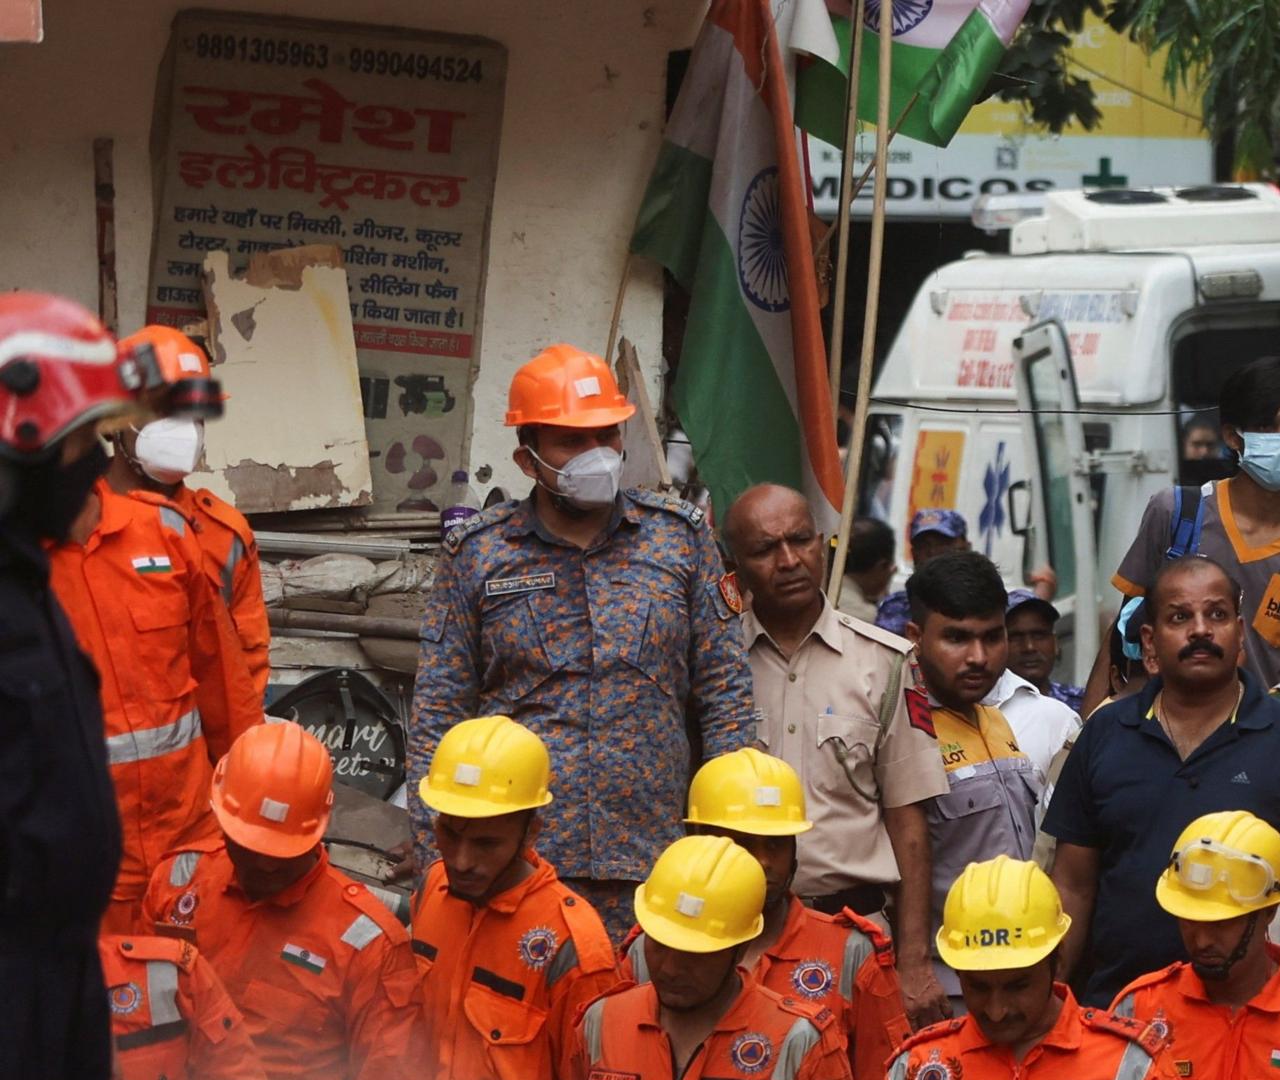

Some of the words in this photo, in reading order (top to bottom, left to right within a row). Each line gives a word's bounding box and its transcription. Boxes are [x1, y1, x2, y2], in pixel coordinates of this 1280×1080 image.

[196, 33, 329, 69] 9891305963
[350, 48, 484, 83] 9990494524
[183, 77, 467, 155] रमेश
[178, 144, 469, 210] इलेक्ट्रिकल
[174, 206, 217, 225] हमारे
[221, 208, 257, 228] यहाँ
[259, 213, 284, 230] पर
[352, 218, 409, 243] गीजर,
[415, 228, 463, 254] कूलर
[362, 301, 401, 324] किया
[403, 307, 441, 326] जाता
